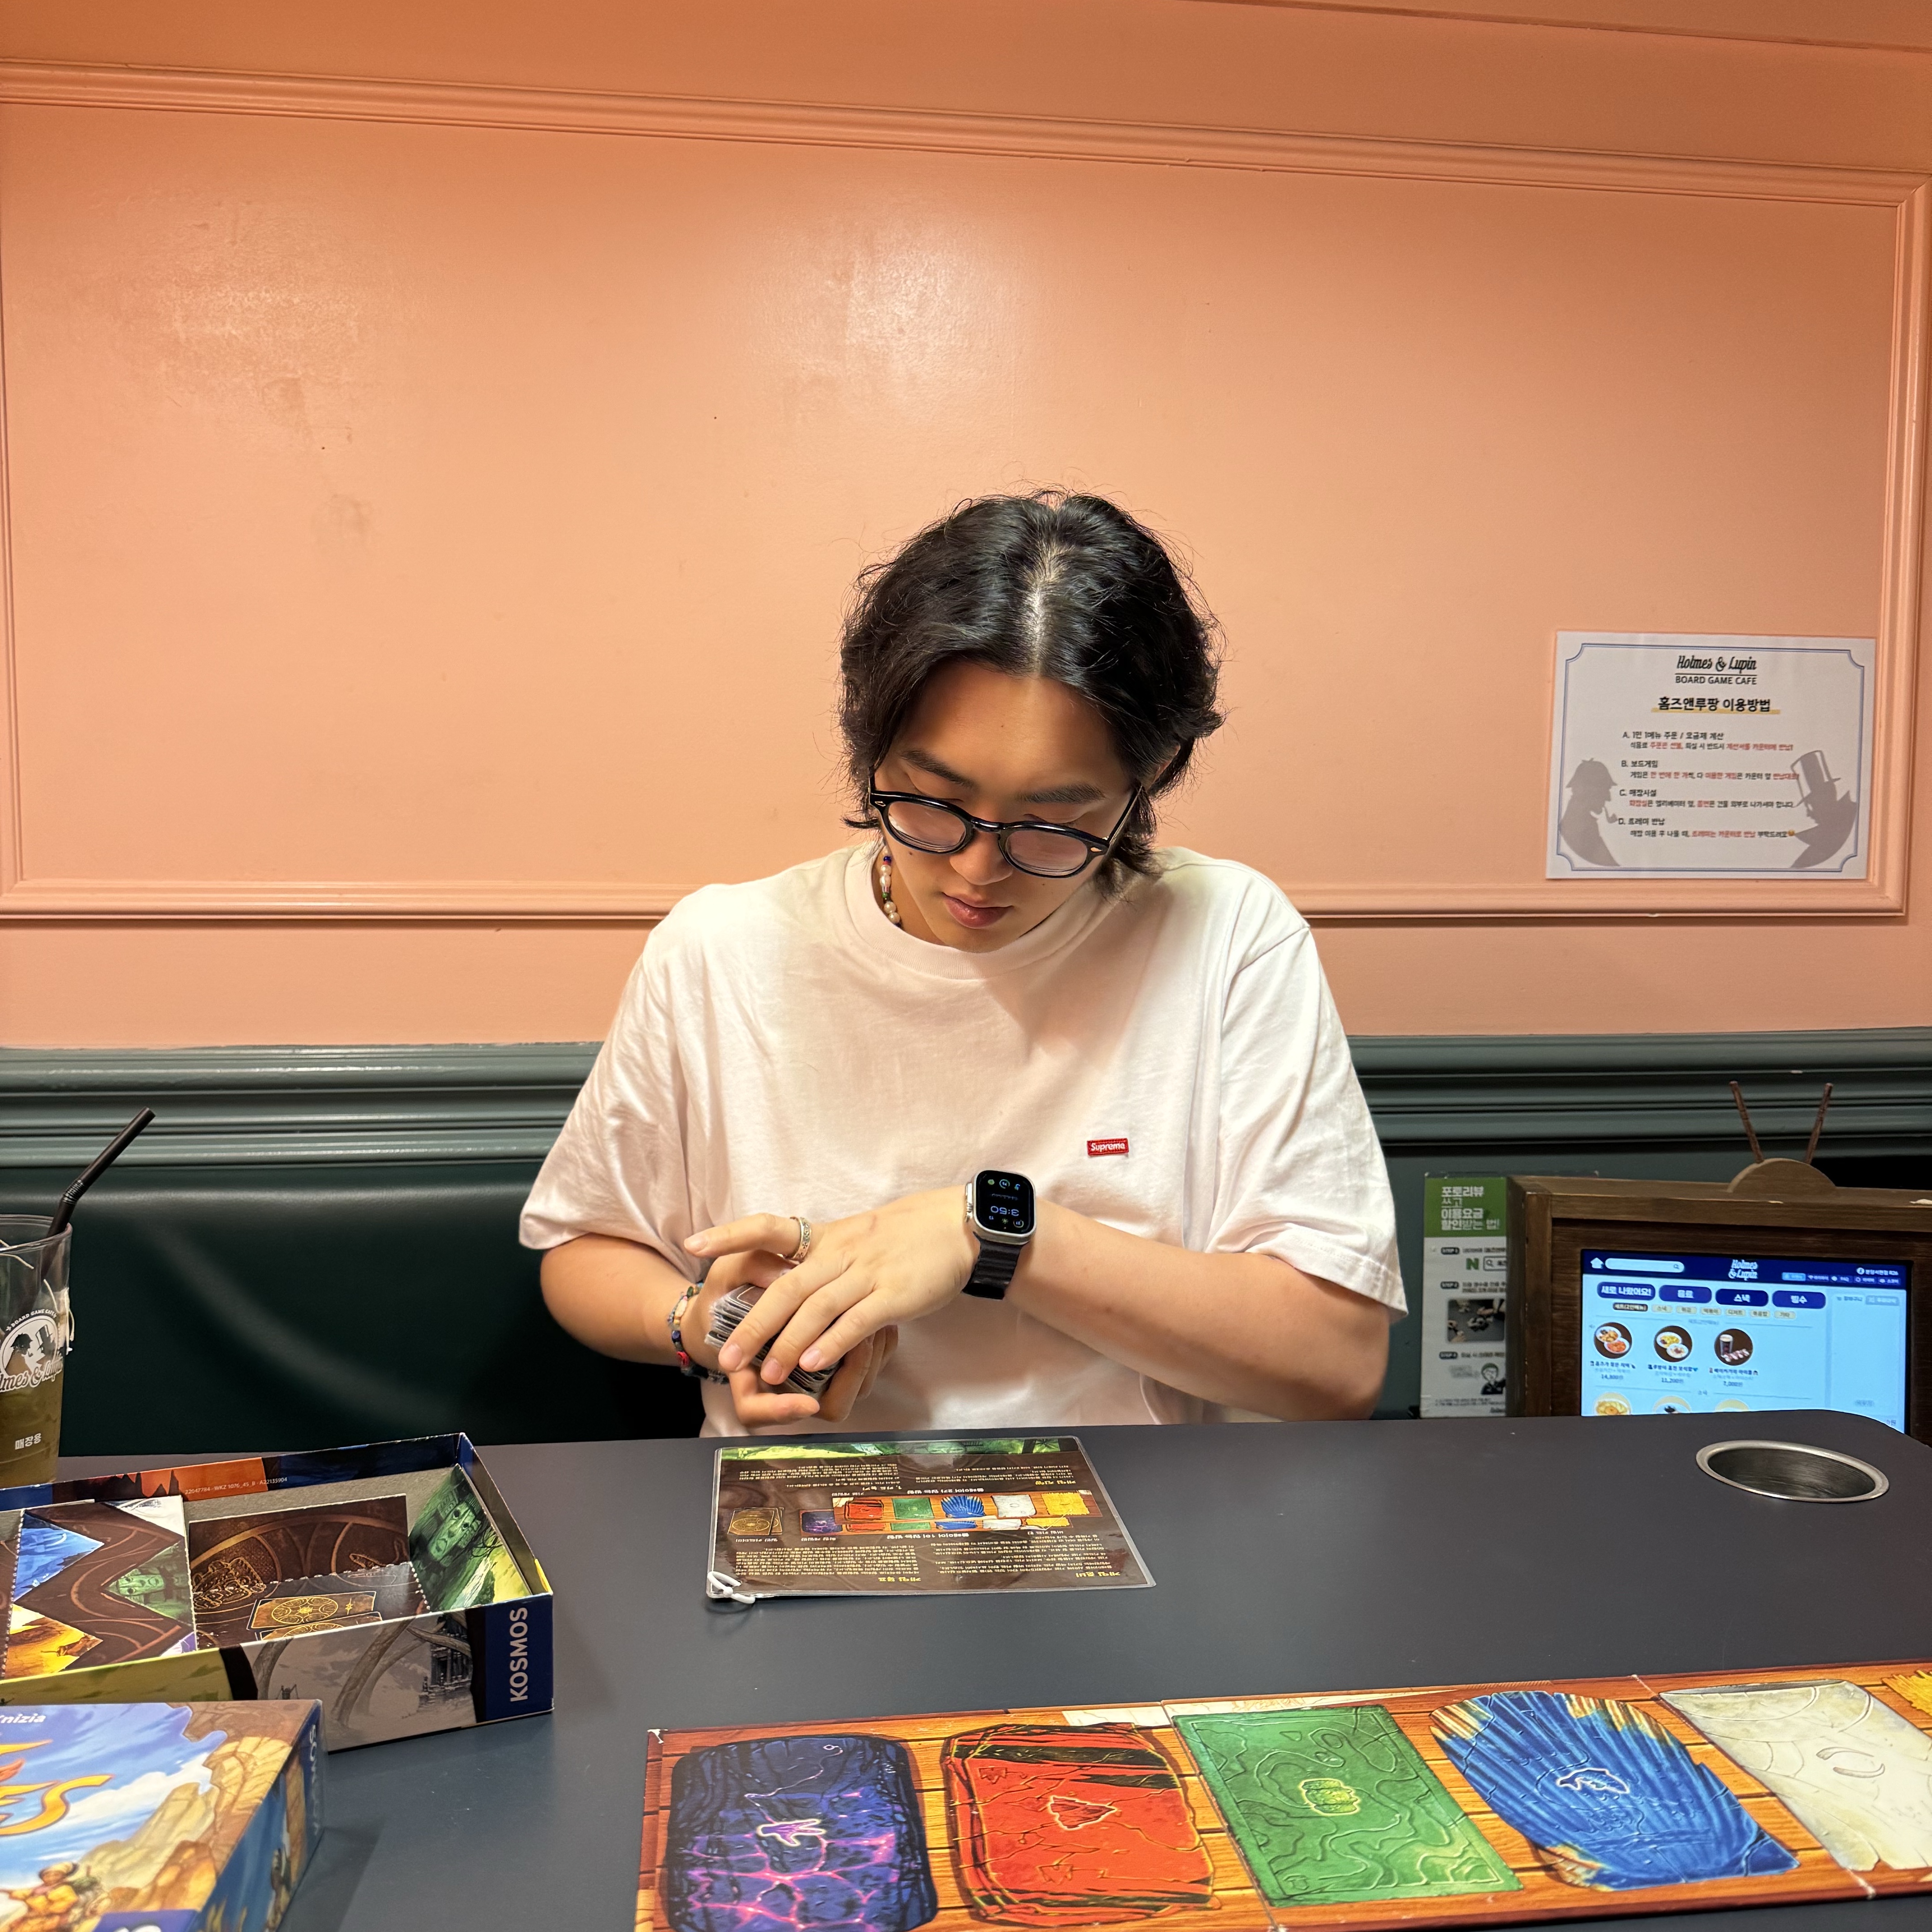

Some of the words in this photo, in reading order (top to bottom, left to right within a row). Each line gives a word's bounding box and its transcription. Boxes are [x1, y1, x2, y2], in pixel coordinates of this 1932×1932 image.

[1676, 655, 1713, 669] Holmes
[1715, 657, 1727, 672] &
[1728, 656, 1757, 674] Lupin
[1675, 676, 1706, 684] BOARD
[1658, 696, 1720, 712] 홈즈앤루팡
[1723, 698, 1771, 713] 이용방법
[1630, 760, 1658, 768] 보드게임
[1091, 1142, 1126, 1152] Supreme
[1441, 1186, 1484, 1197] 포토리뷰
[1441, 1208, 1484, 1219] 이용요금
[1601, 1286, 1618, 1295] 새로
[1618, 1286, 1651, 1297] 나왔어요!
[1734, 1294, 1751, 1303] 스낵
[12, 1313, 30, 1328] BOARD
[0, 1370, 29, 1393] lmes
[15, 1433, 41, 1450] 매장용
[184, 1486, 211, 1495] 22047784
[509, 1607, 528, 1702] KOSMOS
